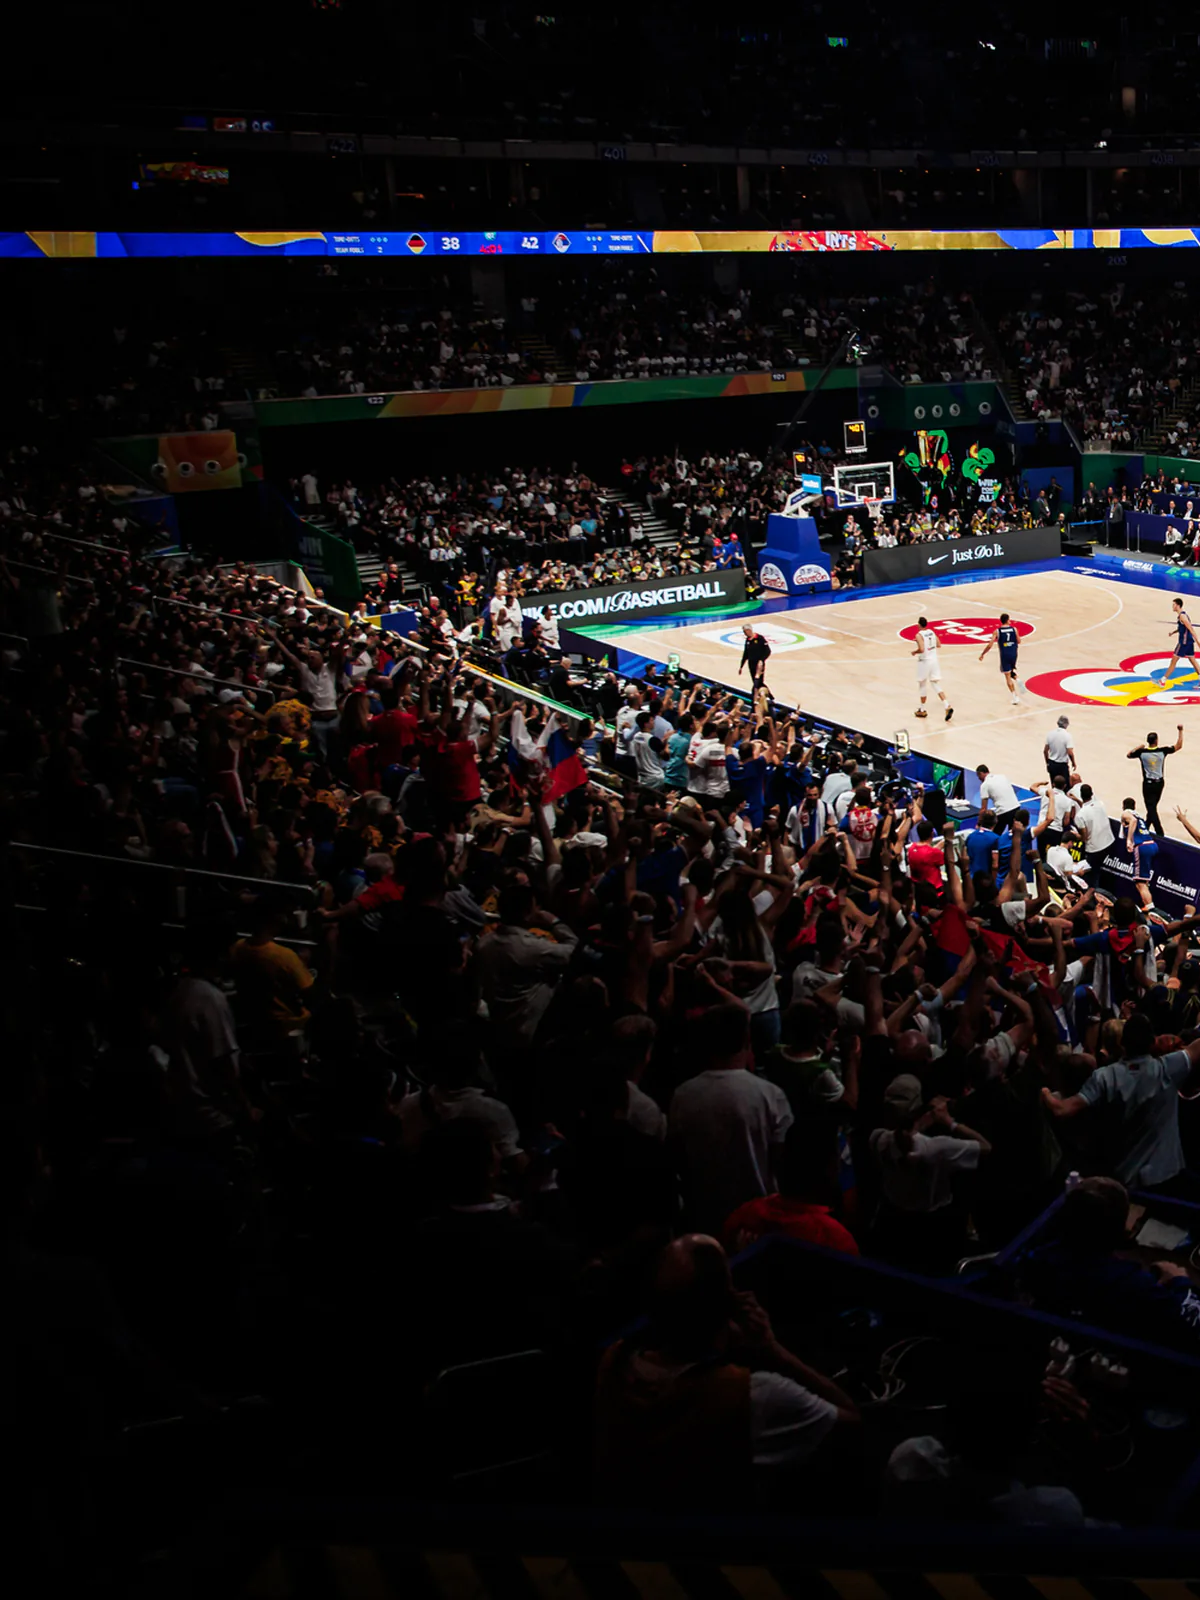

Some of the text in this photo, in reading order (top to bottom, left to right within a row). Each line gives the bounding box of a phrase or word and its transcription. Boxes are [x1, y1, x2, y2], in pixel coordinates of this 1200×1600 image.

[604, 148, 625, 160] 401
[441, 237, 460, 250] 38
[521, 236, 539, 249] 42
[952, 543, 1004, 565] Just Do It.
